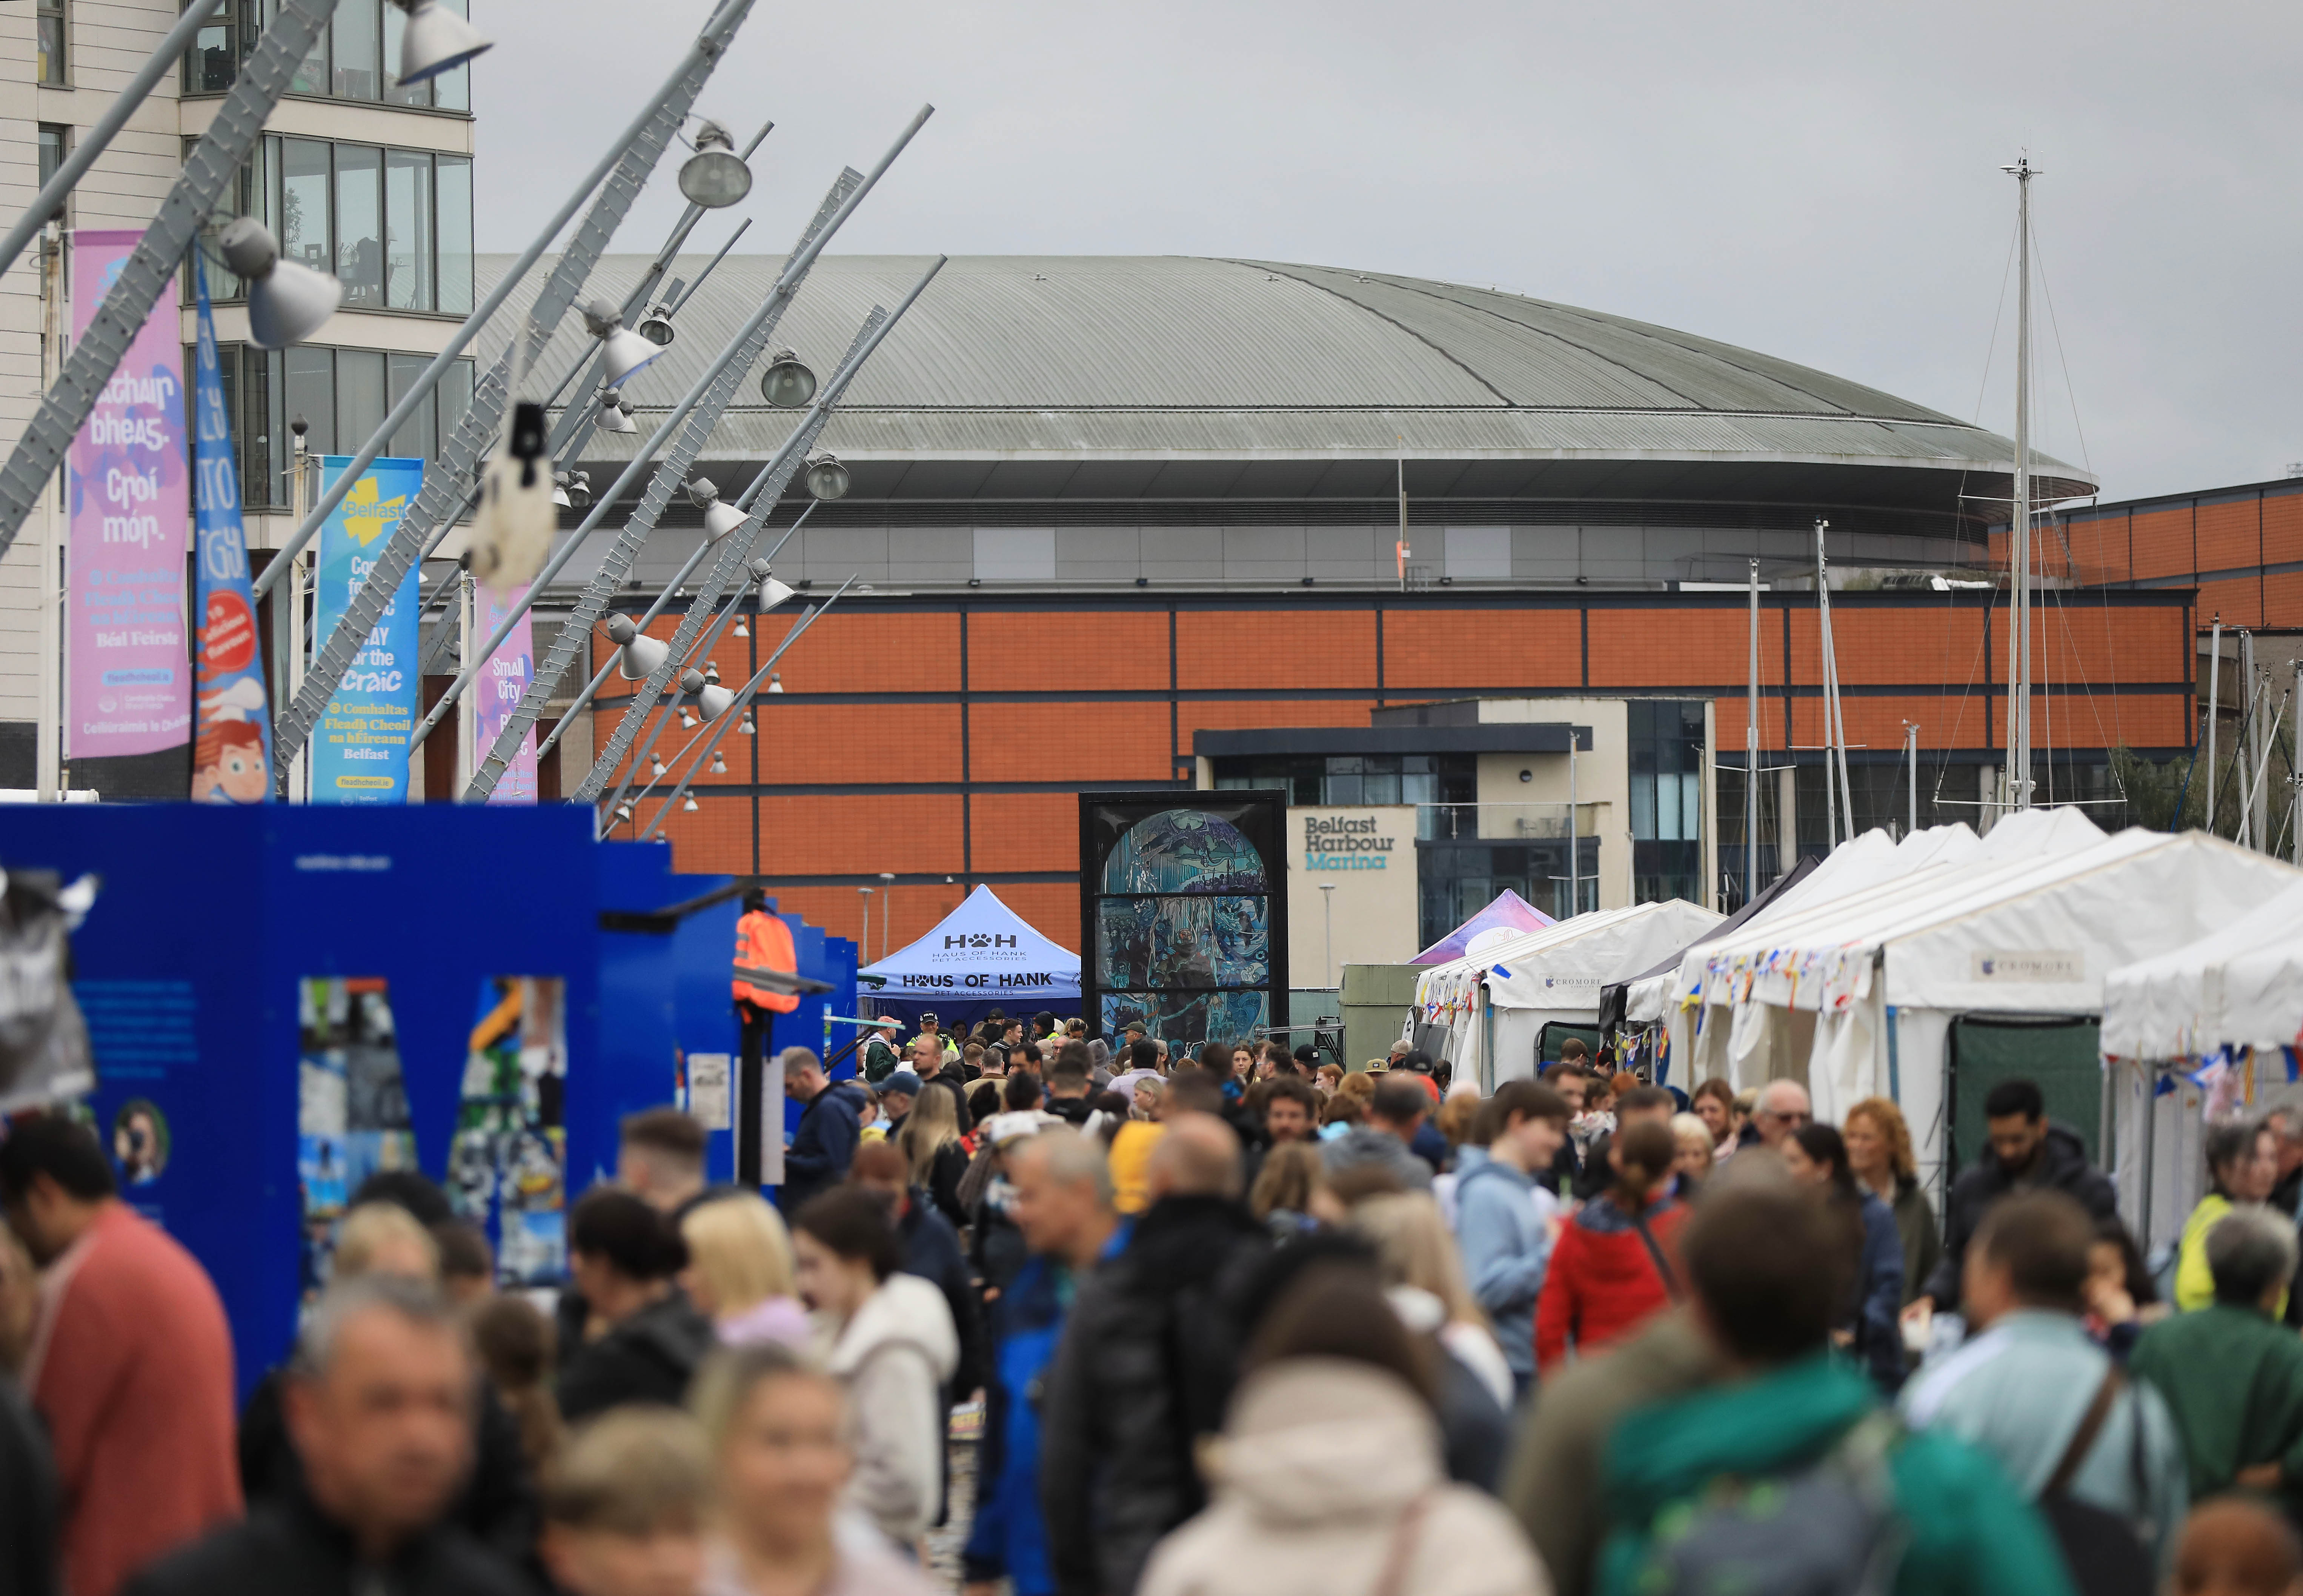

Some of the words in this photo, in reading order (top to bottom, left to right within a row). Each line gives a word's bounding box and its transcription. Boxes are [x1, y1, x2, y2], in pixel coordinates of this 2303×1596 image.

[346, 501, 405, 518] Belfast
[370, 648, 395, 666] the
[492, 657, 524, 677] Small
[498, 680, 521, 704] City
[343, 703, 409, 715] Comhaltas
[324, 718, 367, 730] Fleadh
[369, 719, 411, 730] Cheoil
[329, 734, 344, 743] na
[347, 730, 406, 744] hÉireann
[343, 748, 390, 760] Belfast
[1304, 816, 1377, 833] Belfast
[1305, 834, 1395, 852] Harbour
[1305, 852, 1387, 871] Marina
[964, 974, 989, 987] OF
[999, 973, 1053, 987] HANK
